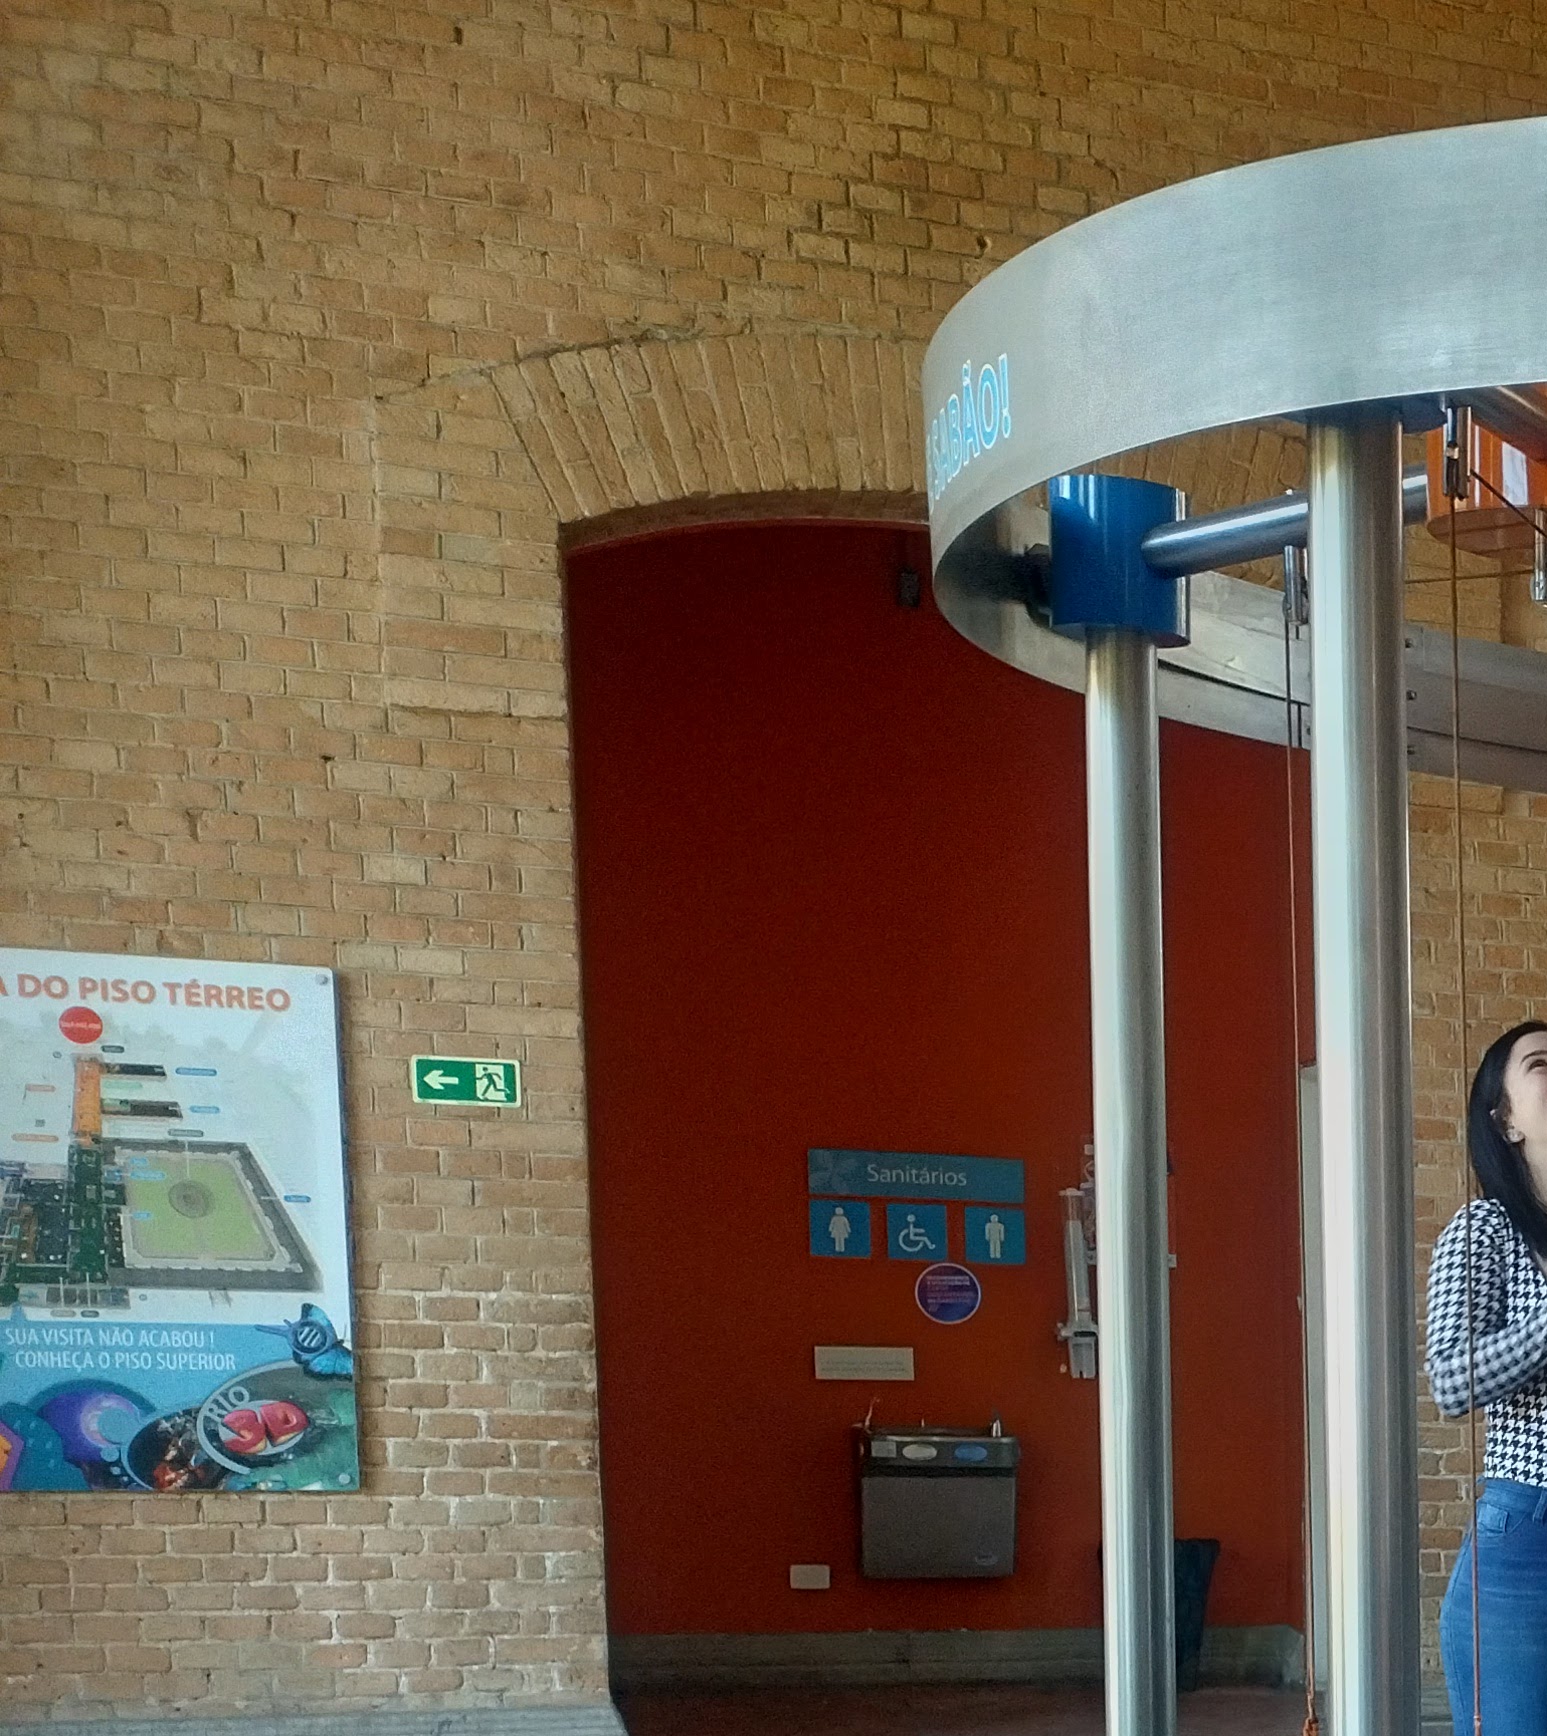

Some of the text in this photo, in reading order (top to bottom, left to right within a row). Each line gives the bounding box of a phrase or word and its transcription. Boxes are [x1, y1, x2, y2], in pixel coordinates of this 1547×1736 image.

[17, 974, 69, 999] DO
[78, 976, 156, 1004] PISO
[162, 978, 291, 1012] TÉRREO
[867, 1163, 968, 1186] Sanitários
[5, 1328, 39, 1345] SUA
[41, 1328, 94, 1346] VISITA
[99, 1327, 134, 1347] NÃO
[138, 1330, 204, 1348] ACABOU
[15, 1350, 236, 1373] CONHEÇA O PISO SUPERIOR
